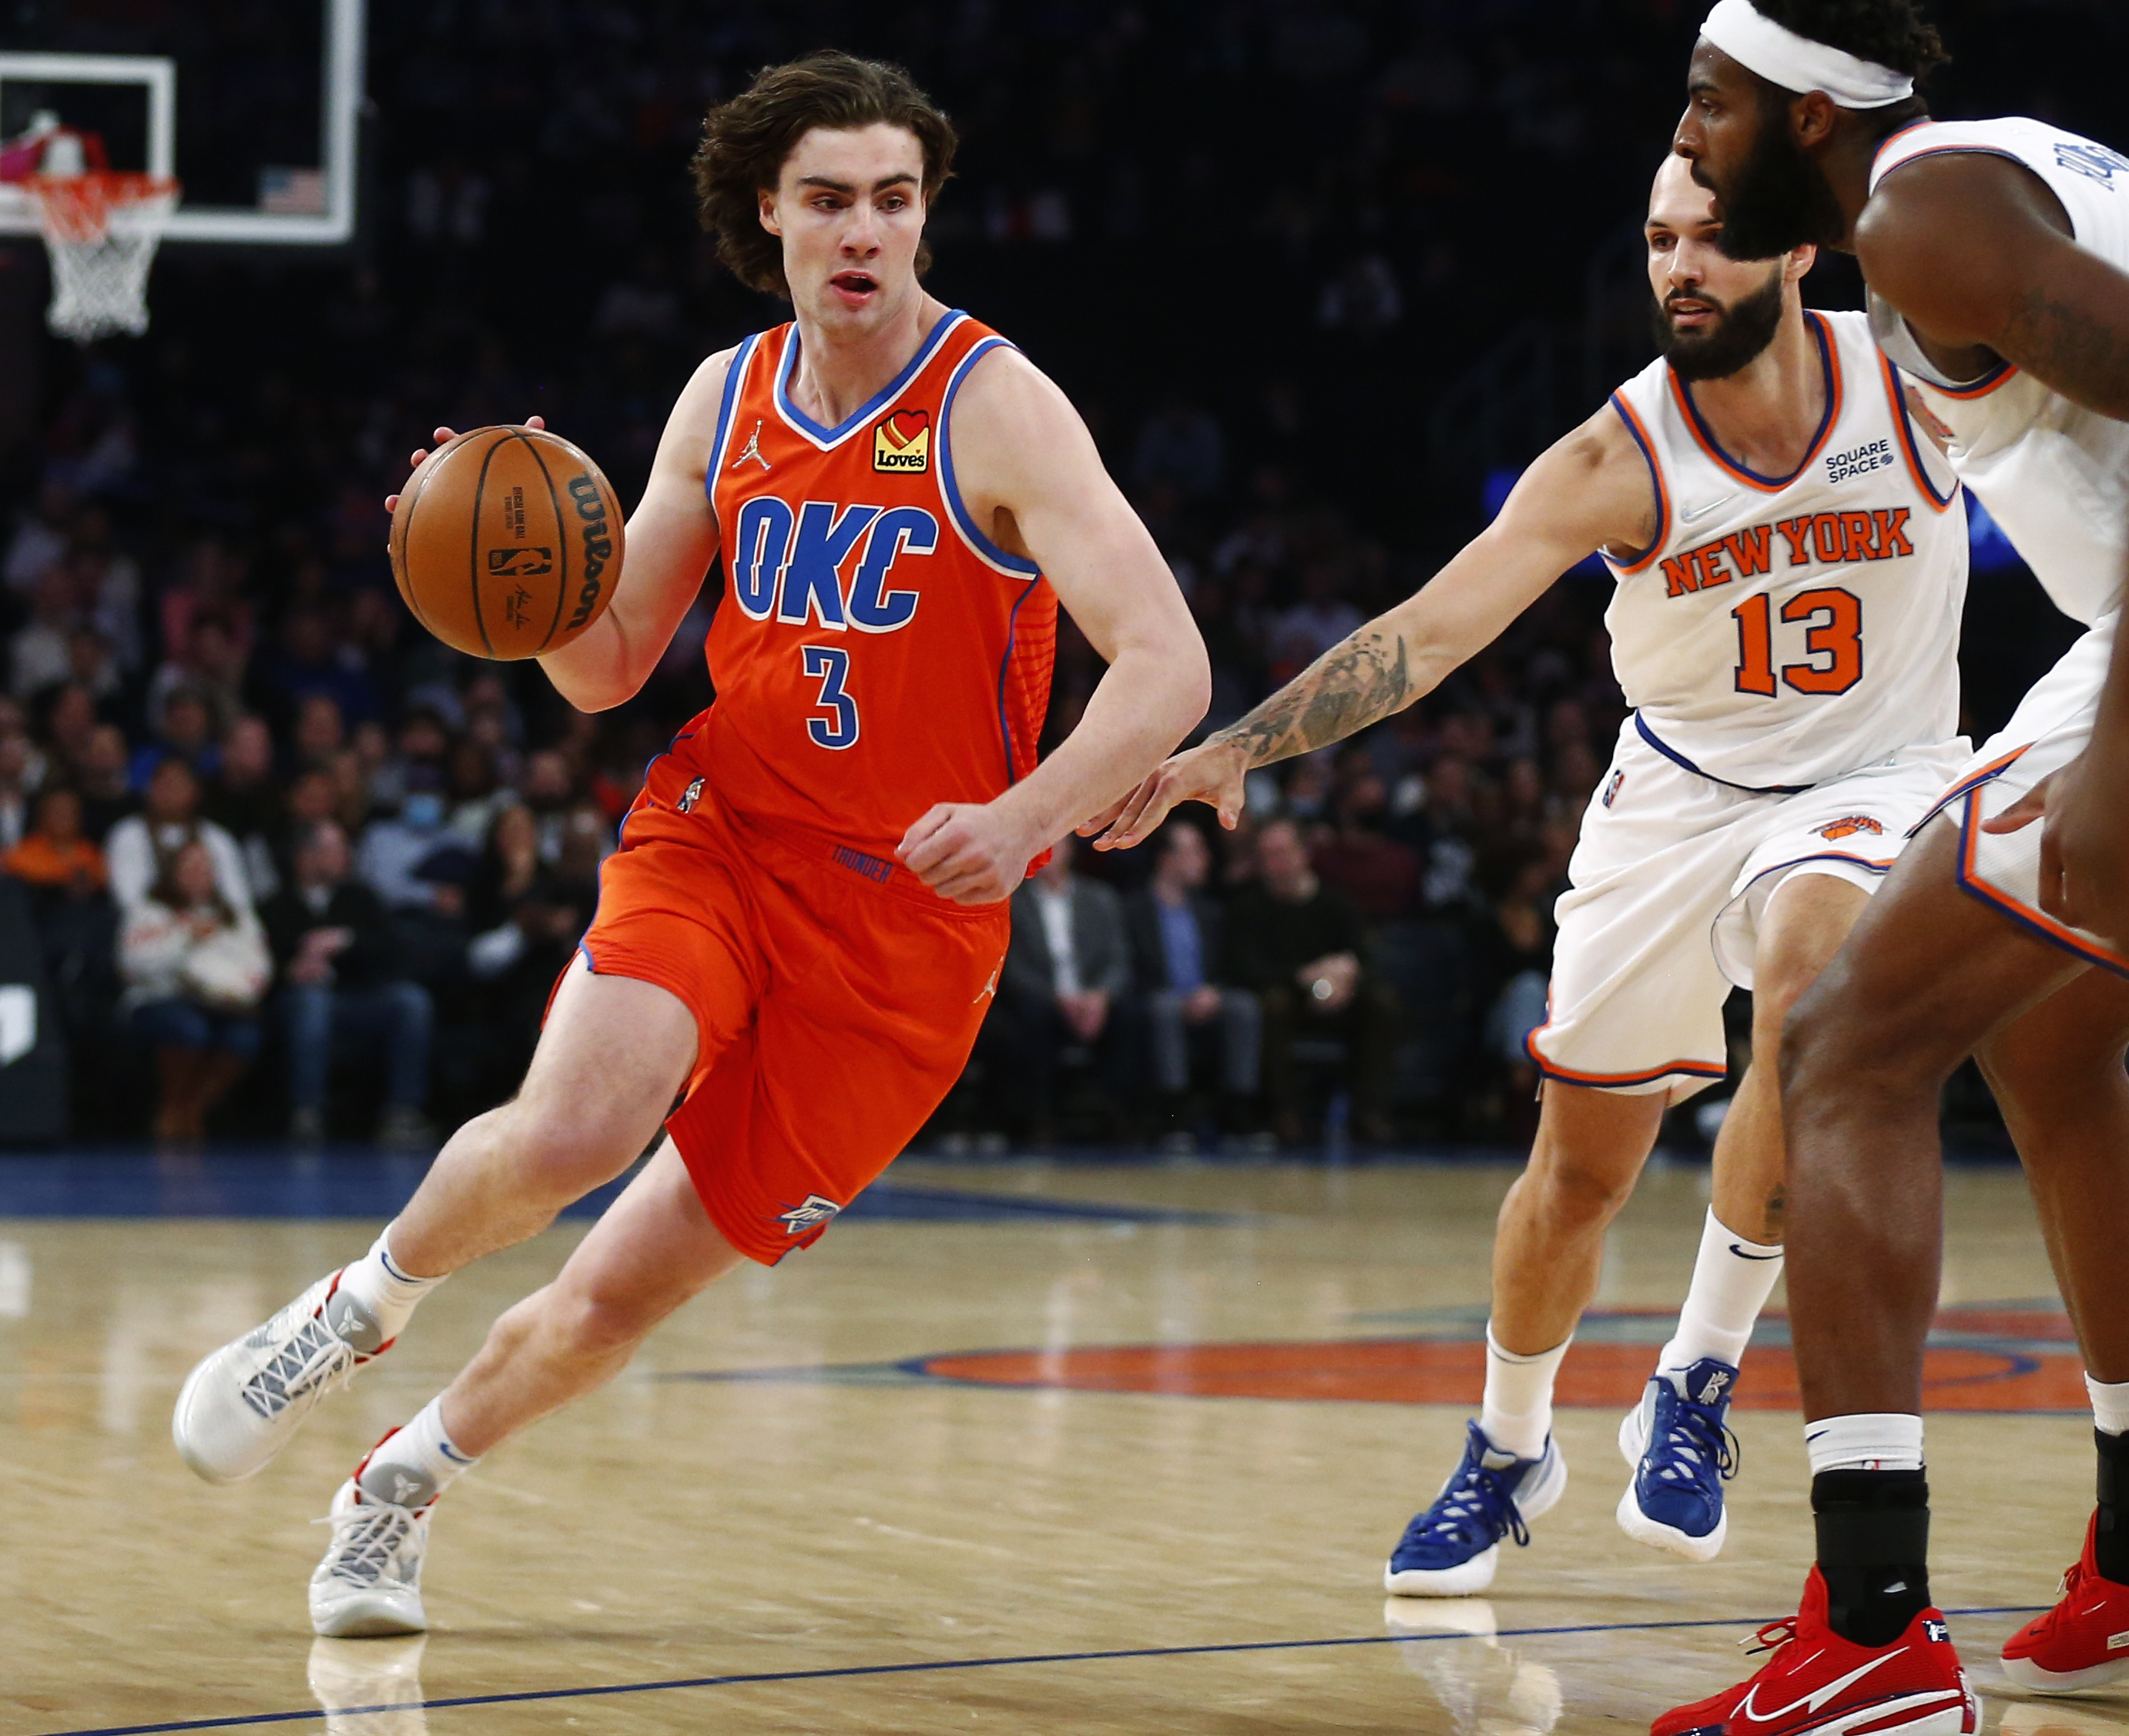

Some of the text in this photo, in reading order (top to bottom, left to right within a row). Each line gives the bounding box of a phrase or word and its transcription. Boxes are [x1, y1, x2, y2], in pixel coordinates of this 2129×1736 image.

[1826, 439, 1889, 470] SQUARE
[1829, 457, 1879, 483] SPACE
[566, 471, 612, 631] Wilson
[733, 495, 939, 634] OKC
[1659, 507, 1913, 598] NEW YORK
[1731, 587, 1863, 698] 13
[800, 645, 860, 751] 3
